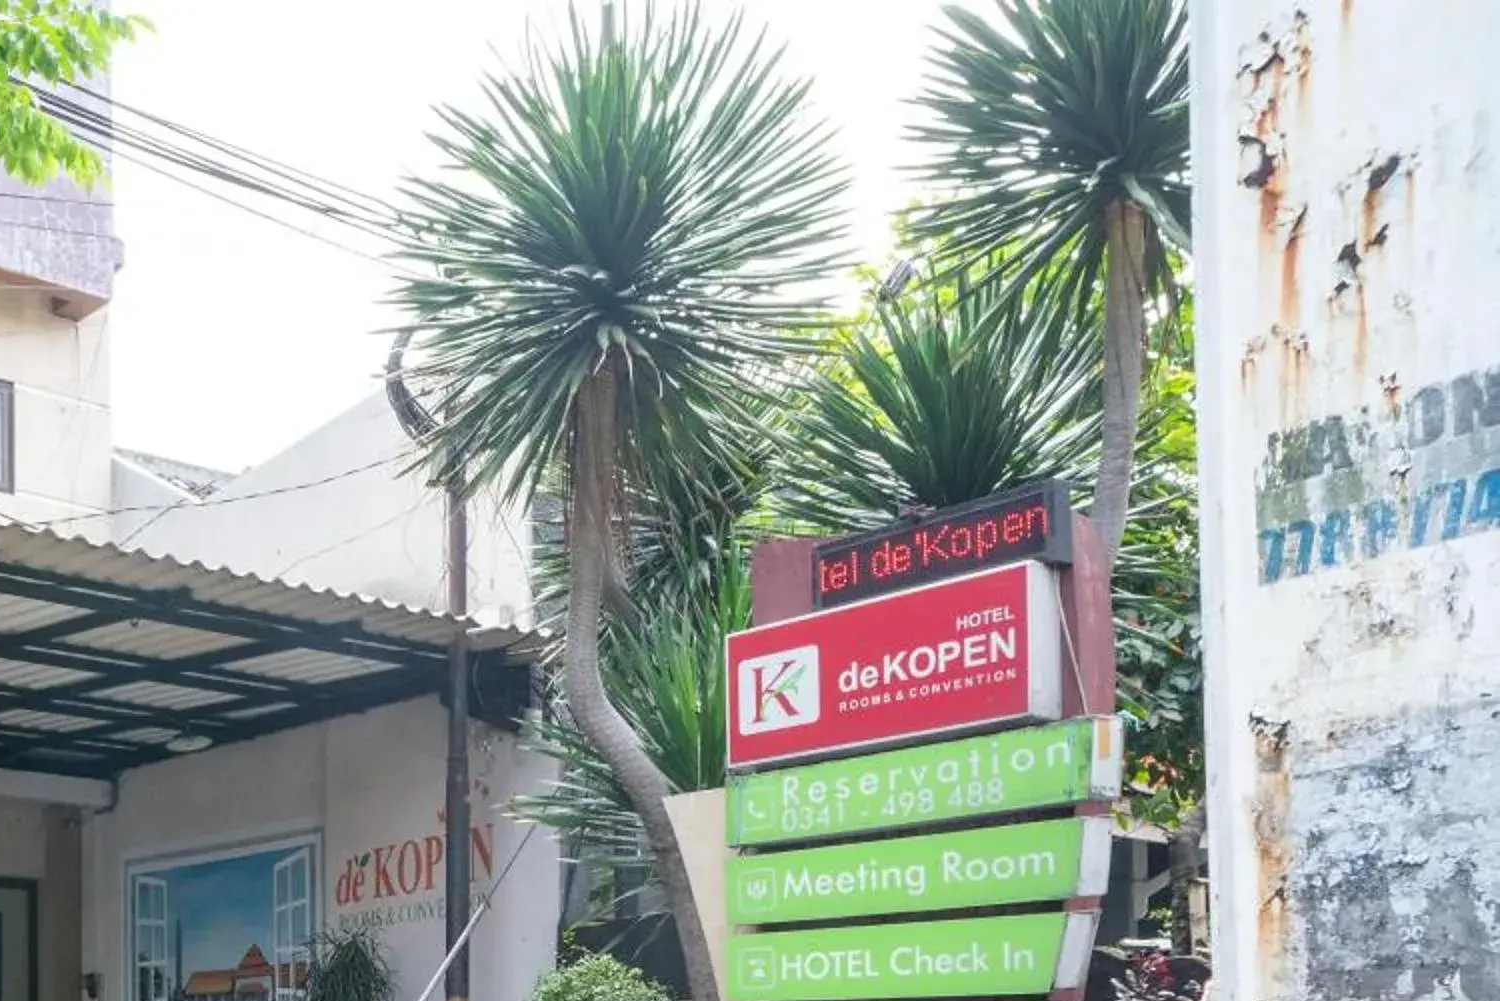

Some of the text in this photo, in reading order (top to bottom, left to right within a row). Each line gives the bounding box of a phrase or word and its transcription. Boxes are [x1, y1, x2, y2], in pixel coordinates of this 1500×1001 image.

[819, 551, 858, 592] tel
[956, 606, 1015, 630] HOTEL
[838, 627, 1016, 693] deKOPEN
[839, 668, 1017, 713] ROOMS & CONVENTION
[781, 741, 1072, 805] Reservation
[781, 801, 844, 833] 0341
[881, 788, 936, 817] 498
[947, 778, 1005, 807] 488
[371, 822, 494, 899] KOPN
[783, 850, 1056, 898] Meeting Room
[781, 942, 1035, 981] HOTEL Check In
